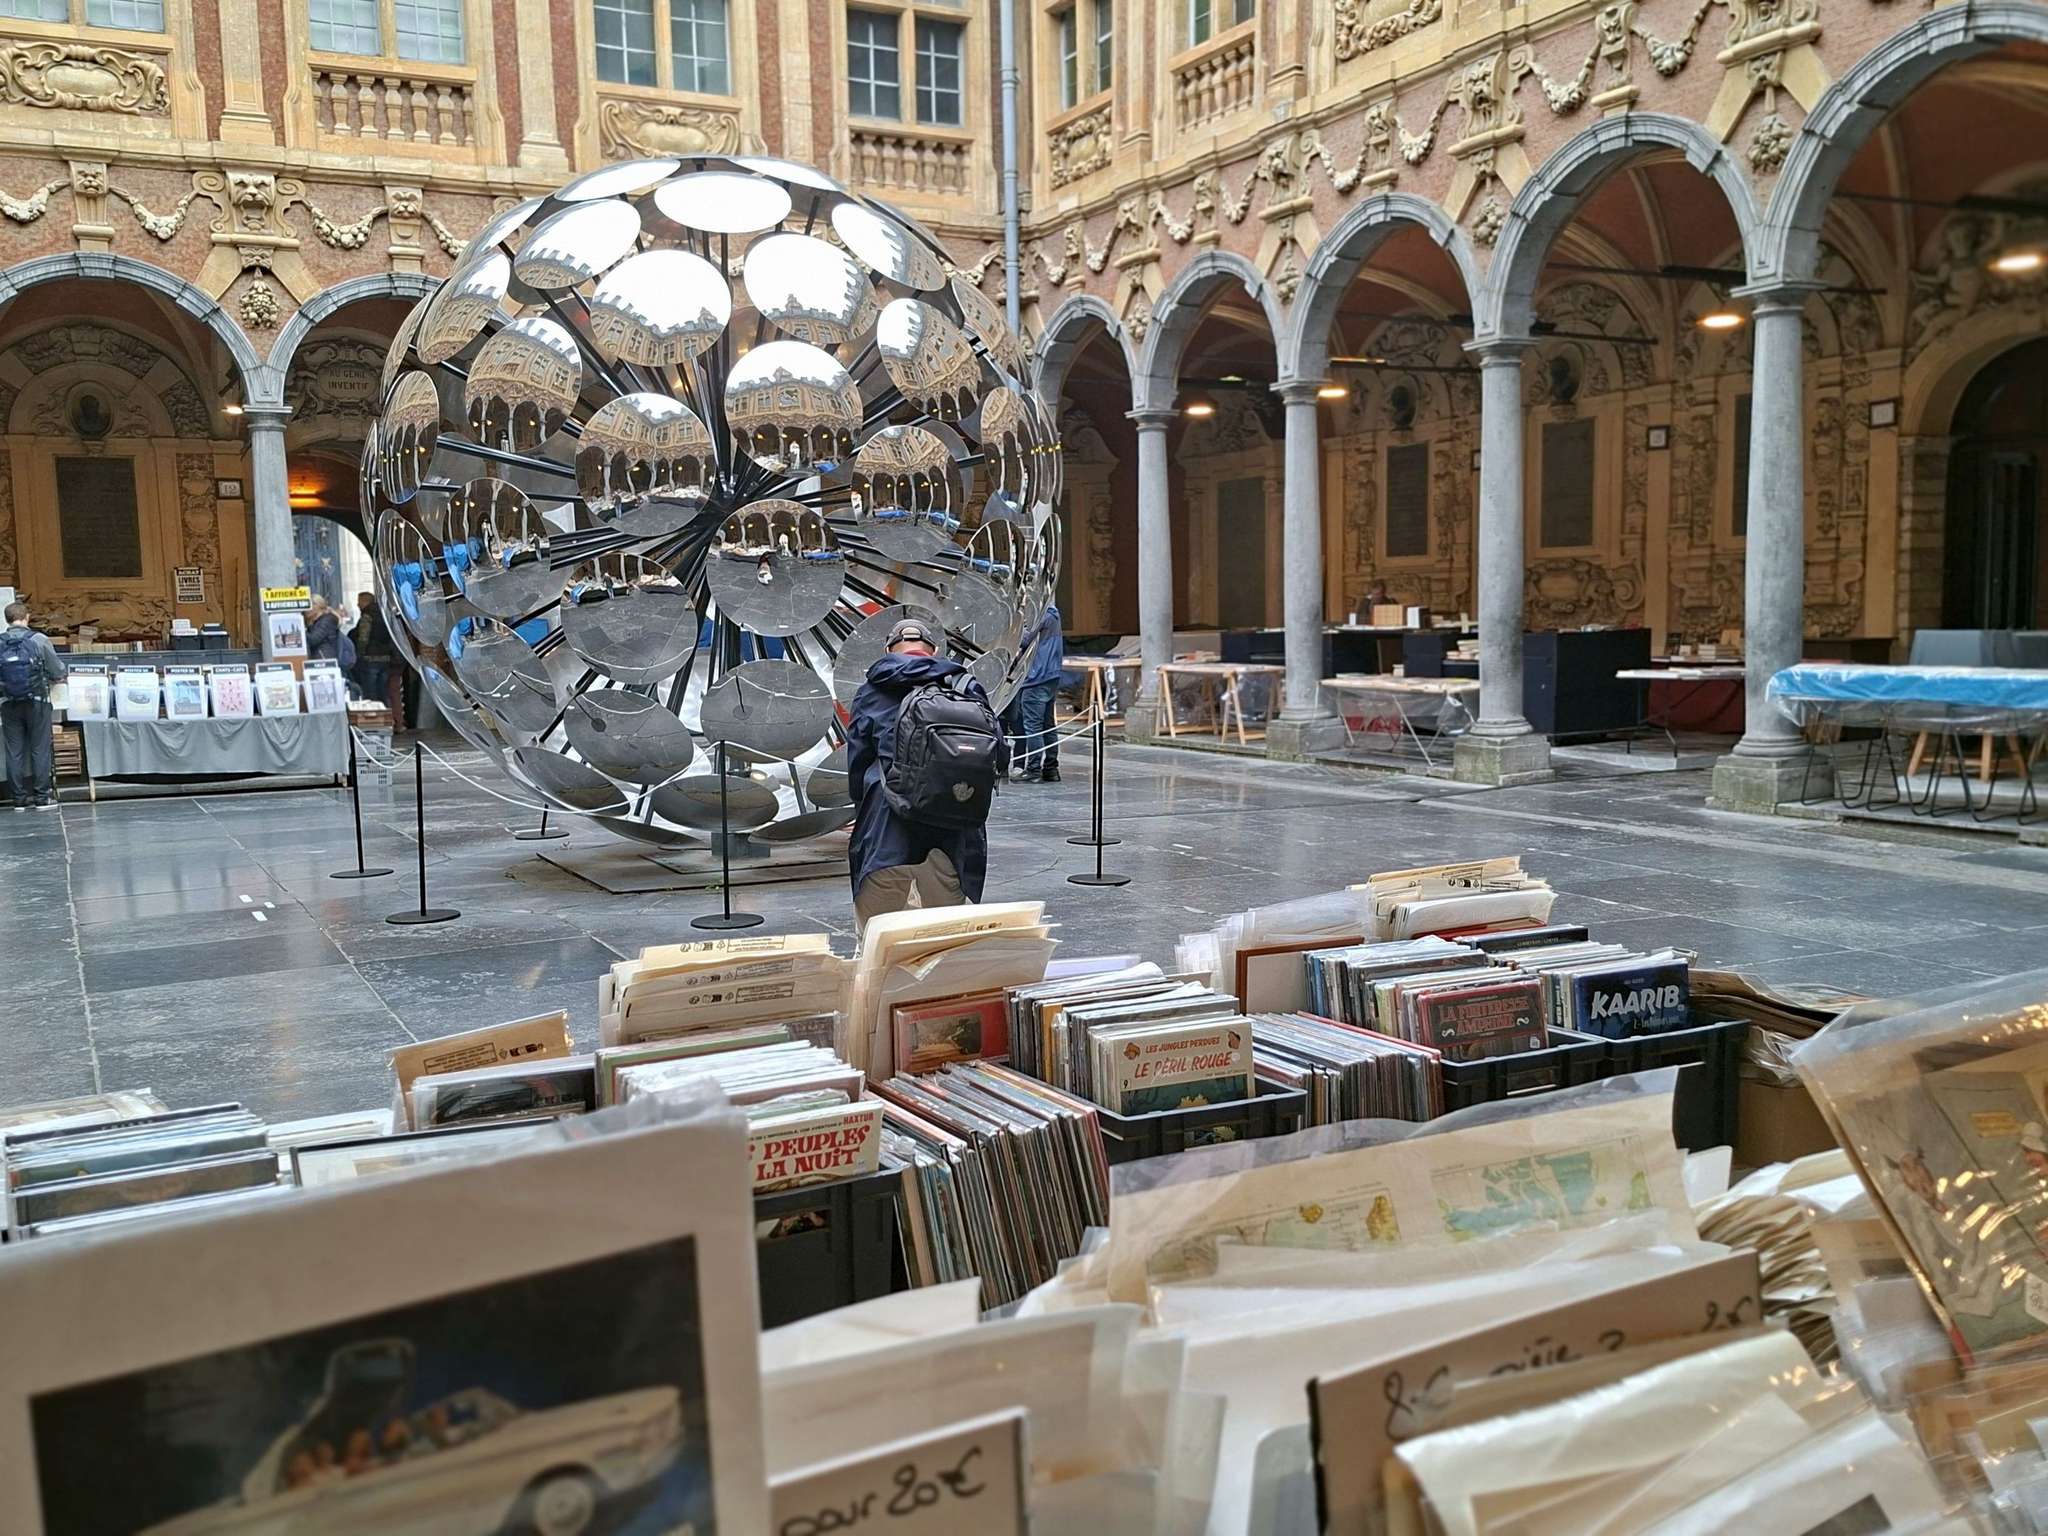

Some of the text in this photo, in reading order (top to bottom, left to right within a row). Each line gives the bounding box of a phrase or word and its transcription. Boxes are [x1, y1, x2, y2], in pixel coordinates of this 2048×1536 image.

[1590, 984, 1680, 1020] KAARIB
[1145, 1037, 1221, 1054] LES JUNGLES PERDUES
[1134, 1062, 1151, 1079] LE
[1153, 1056, 1188, 1077] PÉRIL
[1191, 1051, 1233, 1071] ROUGE
[1123, 1079, 1129, 1089] 9
[763, 1124, 871, 1161] PEUPLES
[757, 1160, 789, 1182] LA
